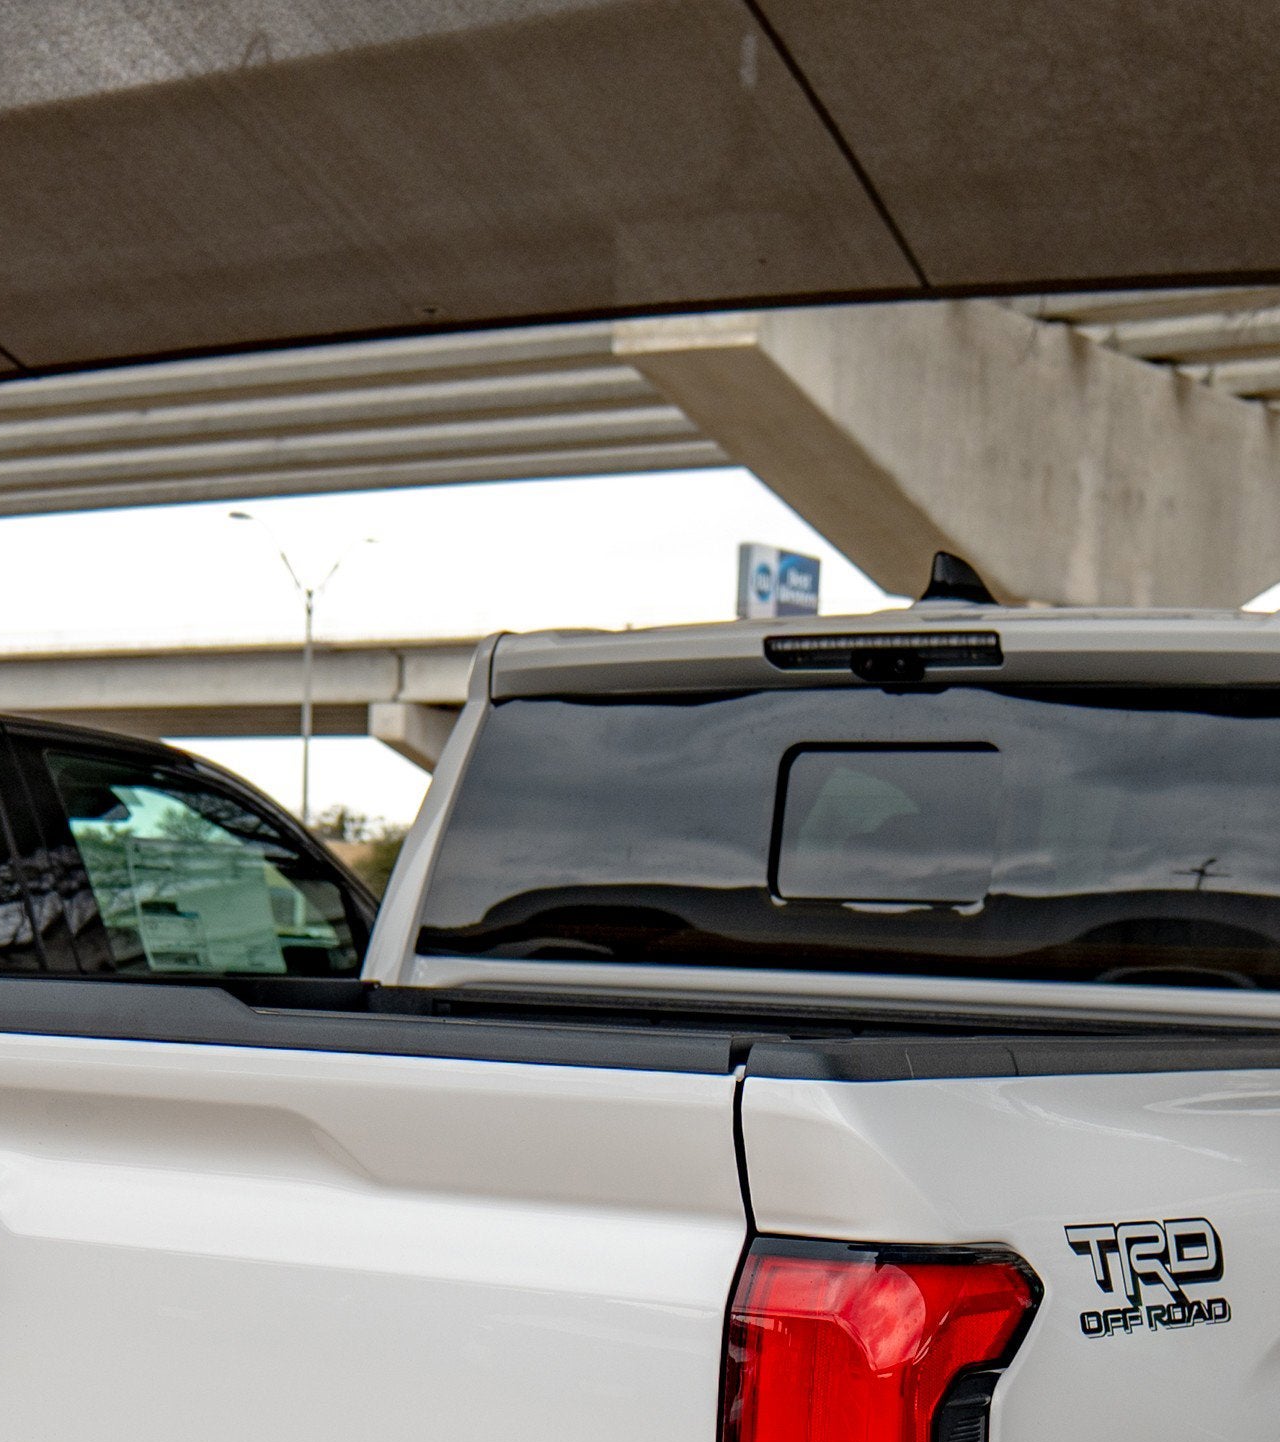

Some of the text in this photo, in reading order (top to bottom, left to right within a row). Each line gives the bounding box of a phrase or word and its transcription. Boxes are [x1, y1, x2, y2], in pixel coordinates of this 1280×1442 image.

[1064, 1217, 1224, 1307] TRD
[1080, 1298, 1231, 1338] OFF ROAD
